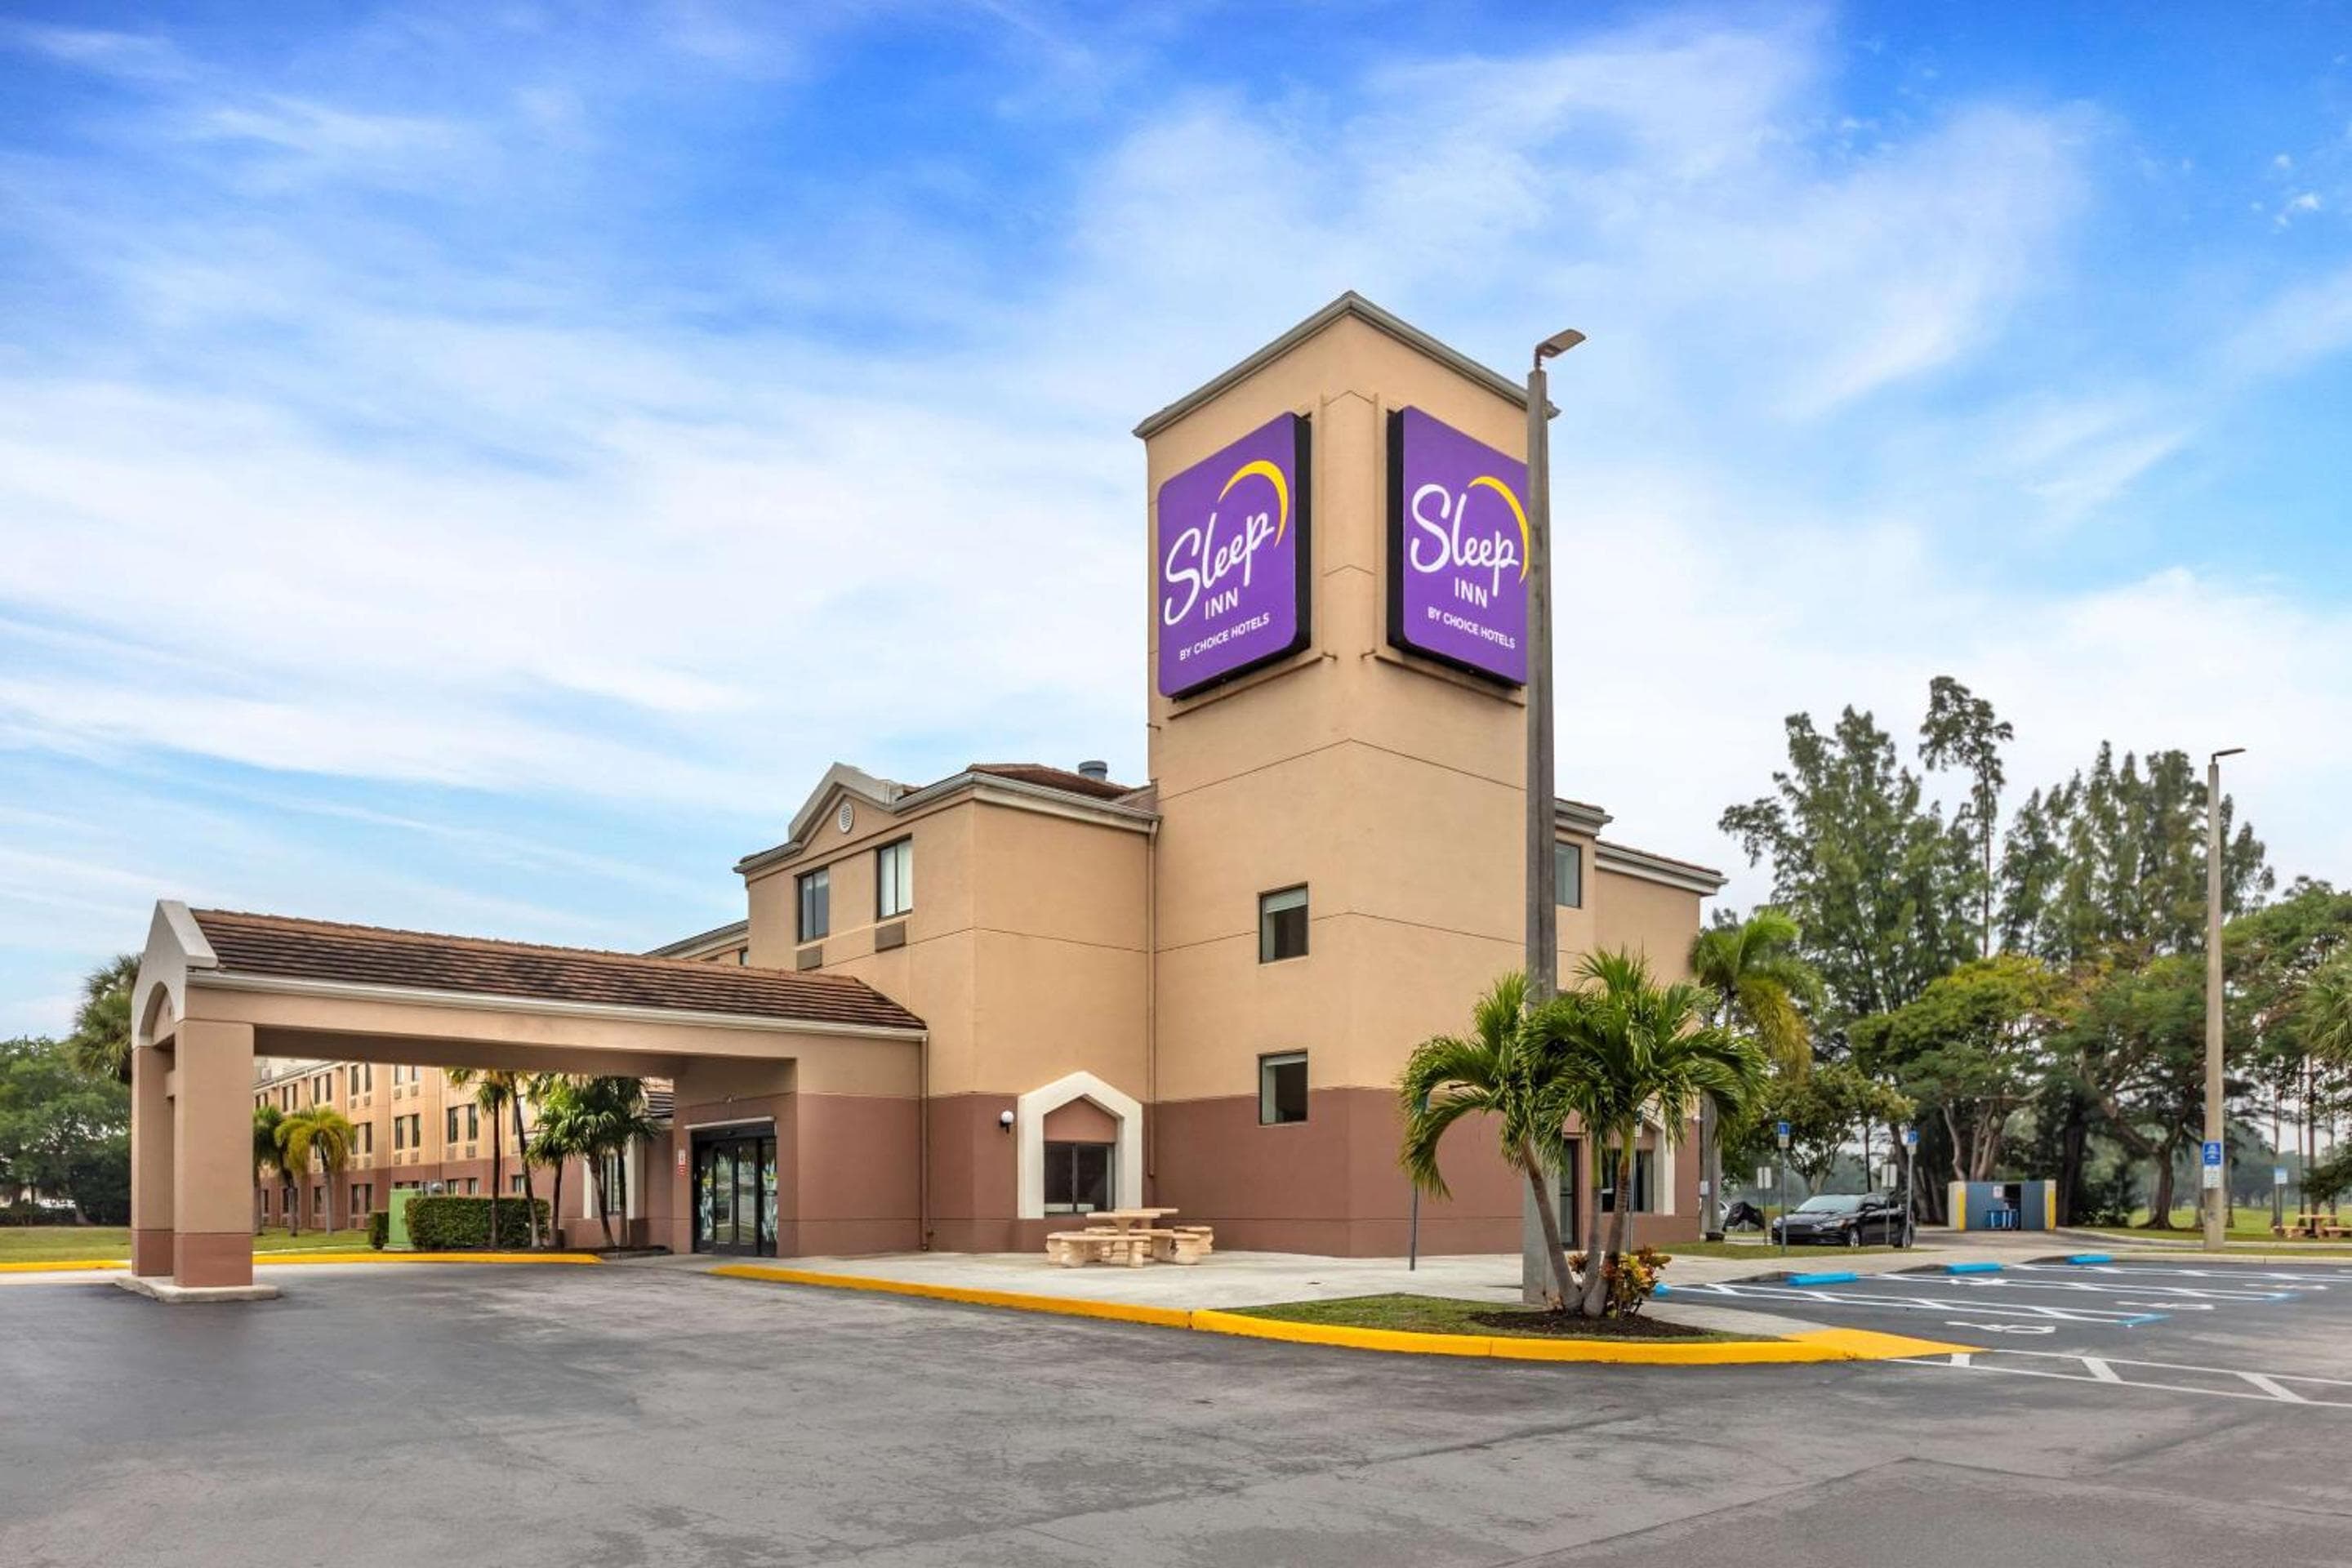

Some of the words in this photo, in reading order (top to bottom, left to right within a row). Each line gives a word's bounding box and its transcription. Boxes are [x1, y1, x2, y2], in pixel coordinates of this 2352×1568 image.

[1410, 483, 1520, 597] Sleep
[1164, 512, 1275, 626] Sleep
[1205, 587, 1239, 621] INN
[1454, 577, 1488, 608] INN
[1179, 647, 1192, 661] BY
[1193, 629, 1229, 655] CHOICE
[1231, 612, 1270, 639] HOTELS
[1428, 606, 1442, 621] BY
[1443, 612, 1479, 635] CHOICE
[1481, 626, 1517, 649] HOTELS
